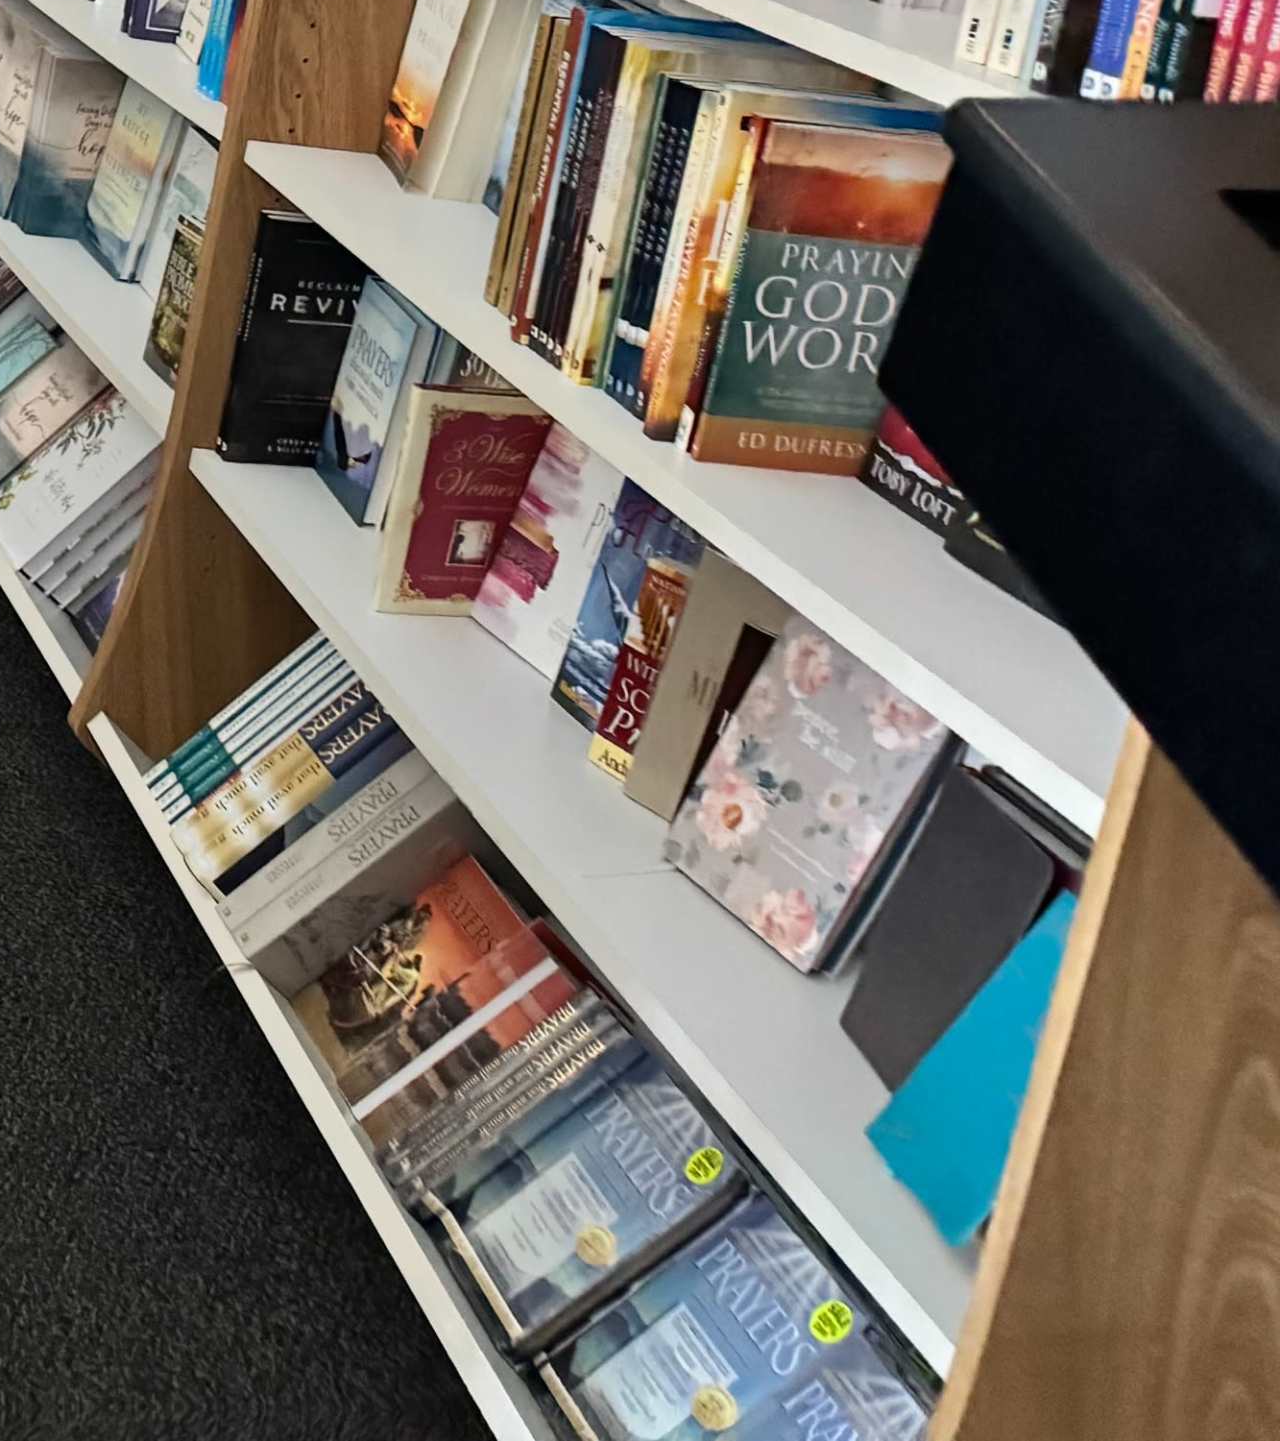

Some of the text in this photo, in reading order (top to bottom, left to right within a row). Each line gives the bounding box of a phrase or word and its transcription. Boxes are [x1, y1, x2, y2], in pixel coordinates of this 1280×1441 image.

[780, 240, 919, 280] PRAYIN
[754, 275, 897, 332] GOD
[743, 318, 883, 376] WOR
[737, 433, 768, 450] ED
[870, 454, 959, 528] TOBY LOFT
[345, 805, 421, 869] PRAYERS
[695, 1236, 816, 1380] PRAYERS
